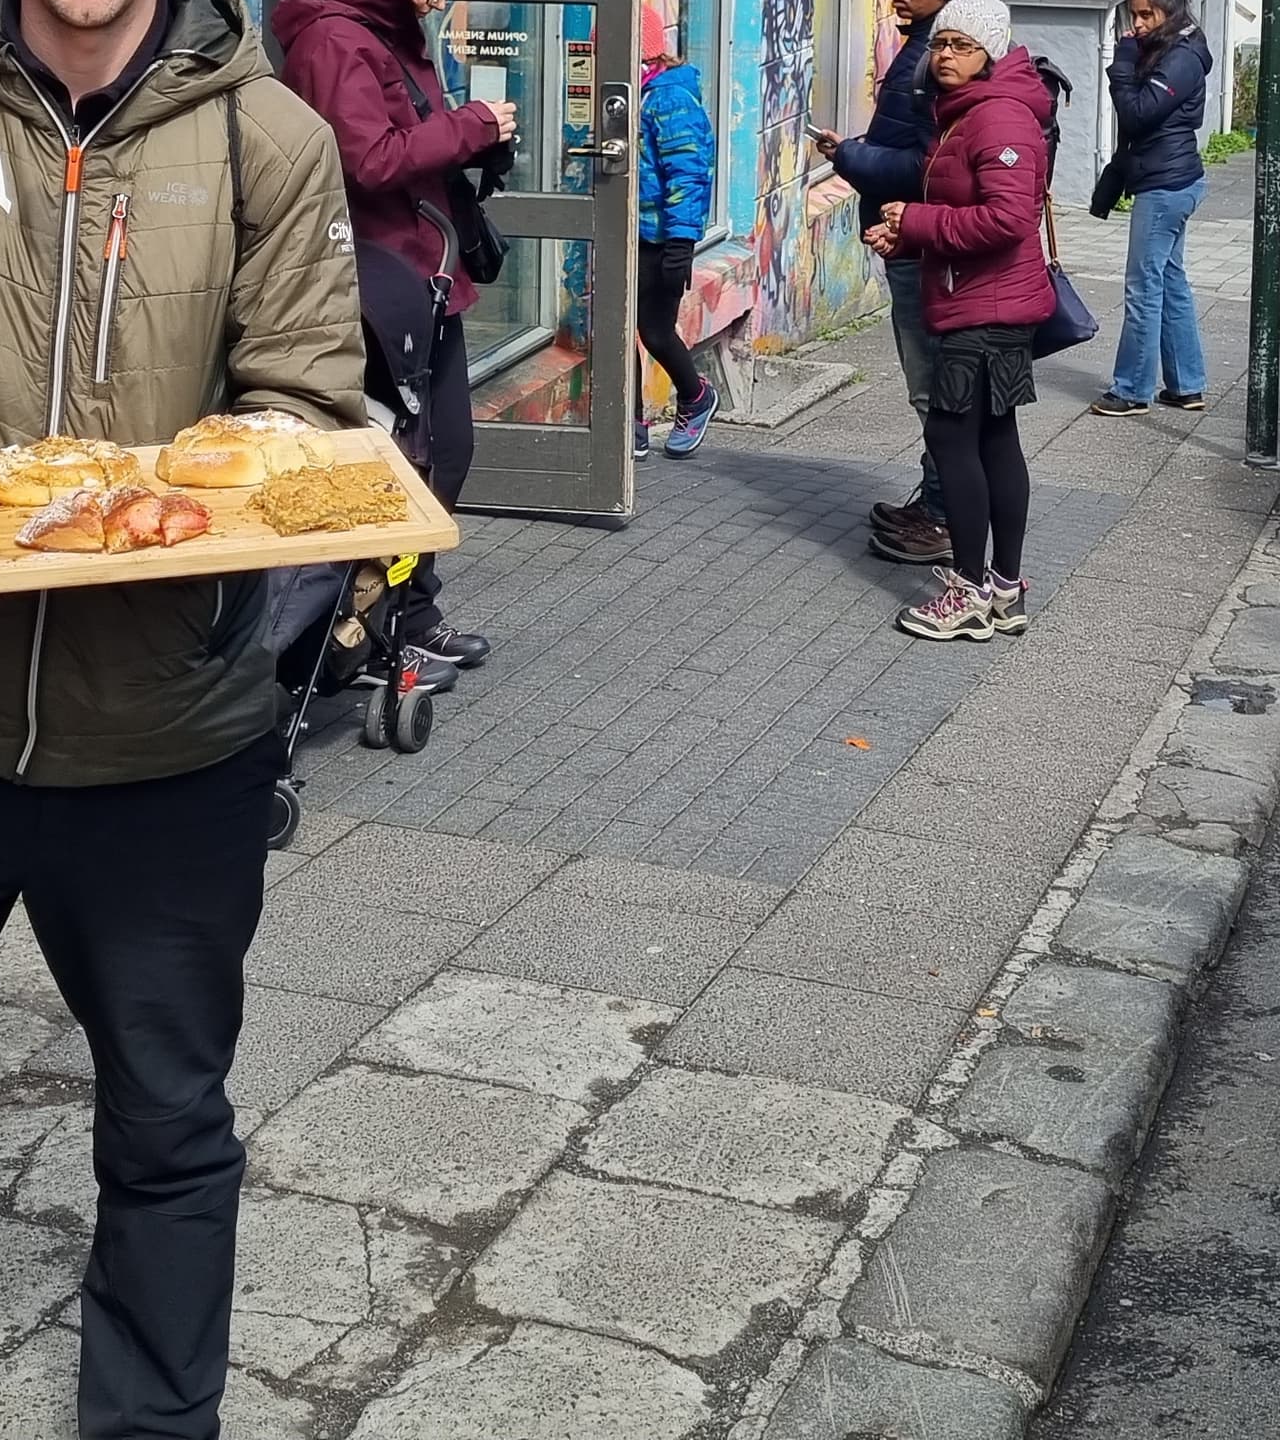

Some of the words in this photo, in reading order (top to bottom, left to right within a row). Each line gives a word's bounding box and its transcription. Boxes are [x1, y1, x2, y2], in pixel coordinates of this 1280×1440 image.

[167, 182, 187, 195] ICE
[148, 191, 187, 205] WEAR
[329, 222, 352, 242] City
